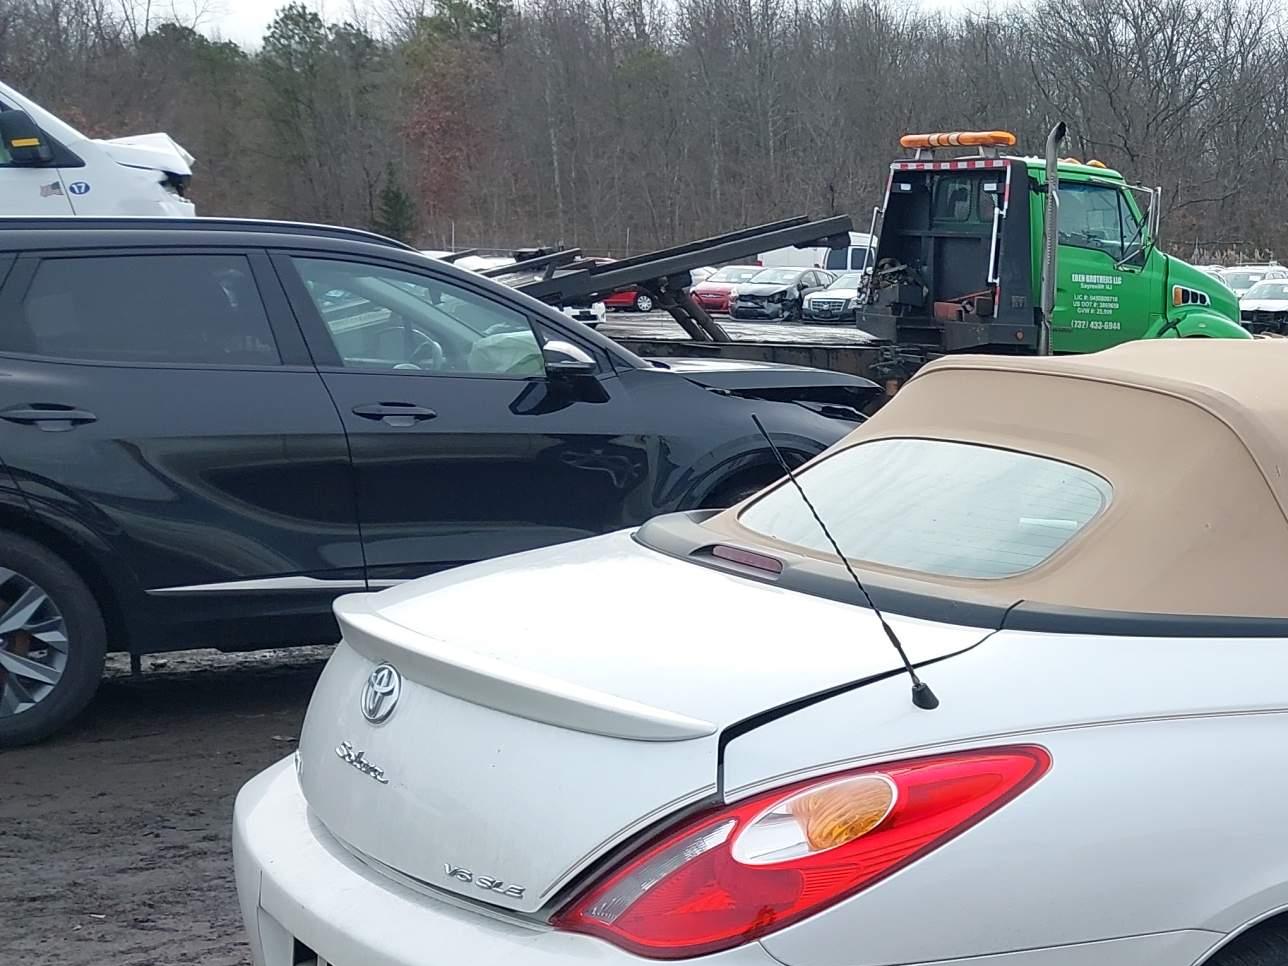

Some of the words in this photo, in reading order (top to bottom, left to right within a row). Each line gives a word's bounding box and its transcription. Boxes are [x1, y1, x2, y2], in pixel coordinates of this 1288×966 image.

[72, 183, 86, 194] 17
[1113, 276, 1122, 285] LLC
[1071, 320, 1089, 329] (732)
[444, 862, 473, 883] V6
[475, 874, 527, 900] SLE
